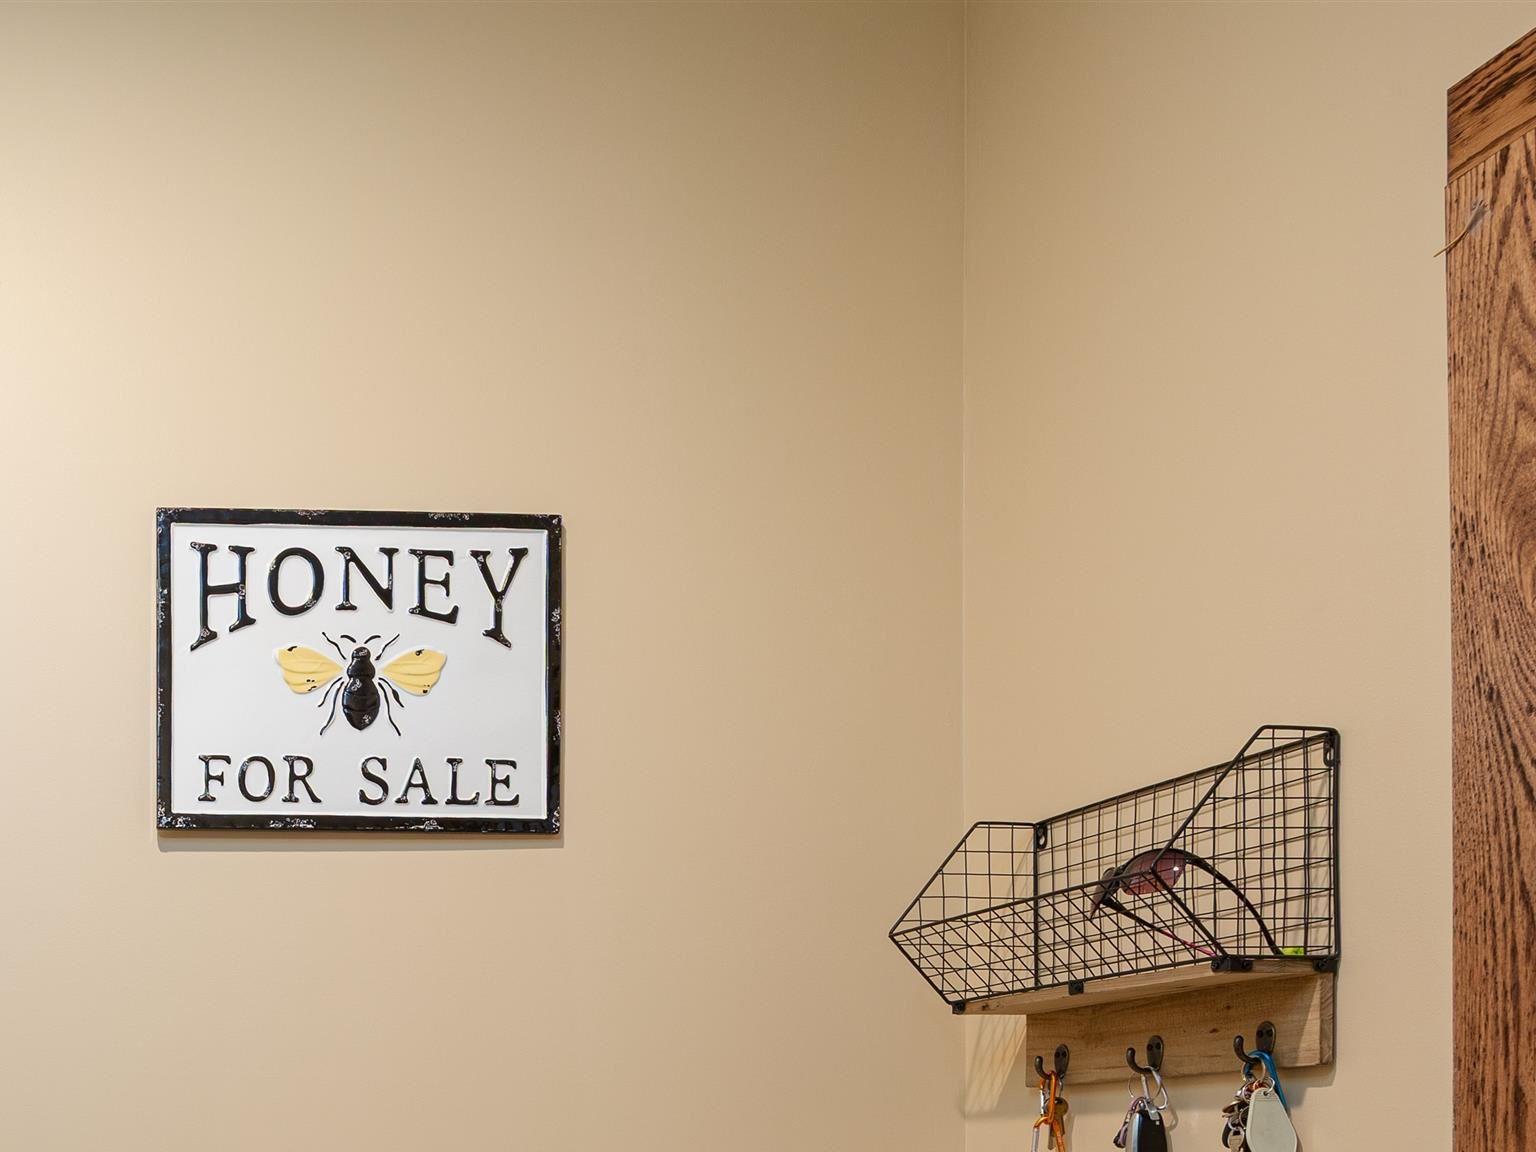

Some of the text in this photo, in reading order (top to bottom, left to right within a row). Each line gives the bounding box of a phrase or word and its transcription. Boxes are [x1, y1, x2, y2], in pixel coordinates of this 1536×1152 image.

[190, 541, 529, 651] HONEY
[198, 755, 520, 806] FOR SALE
